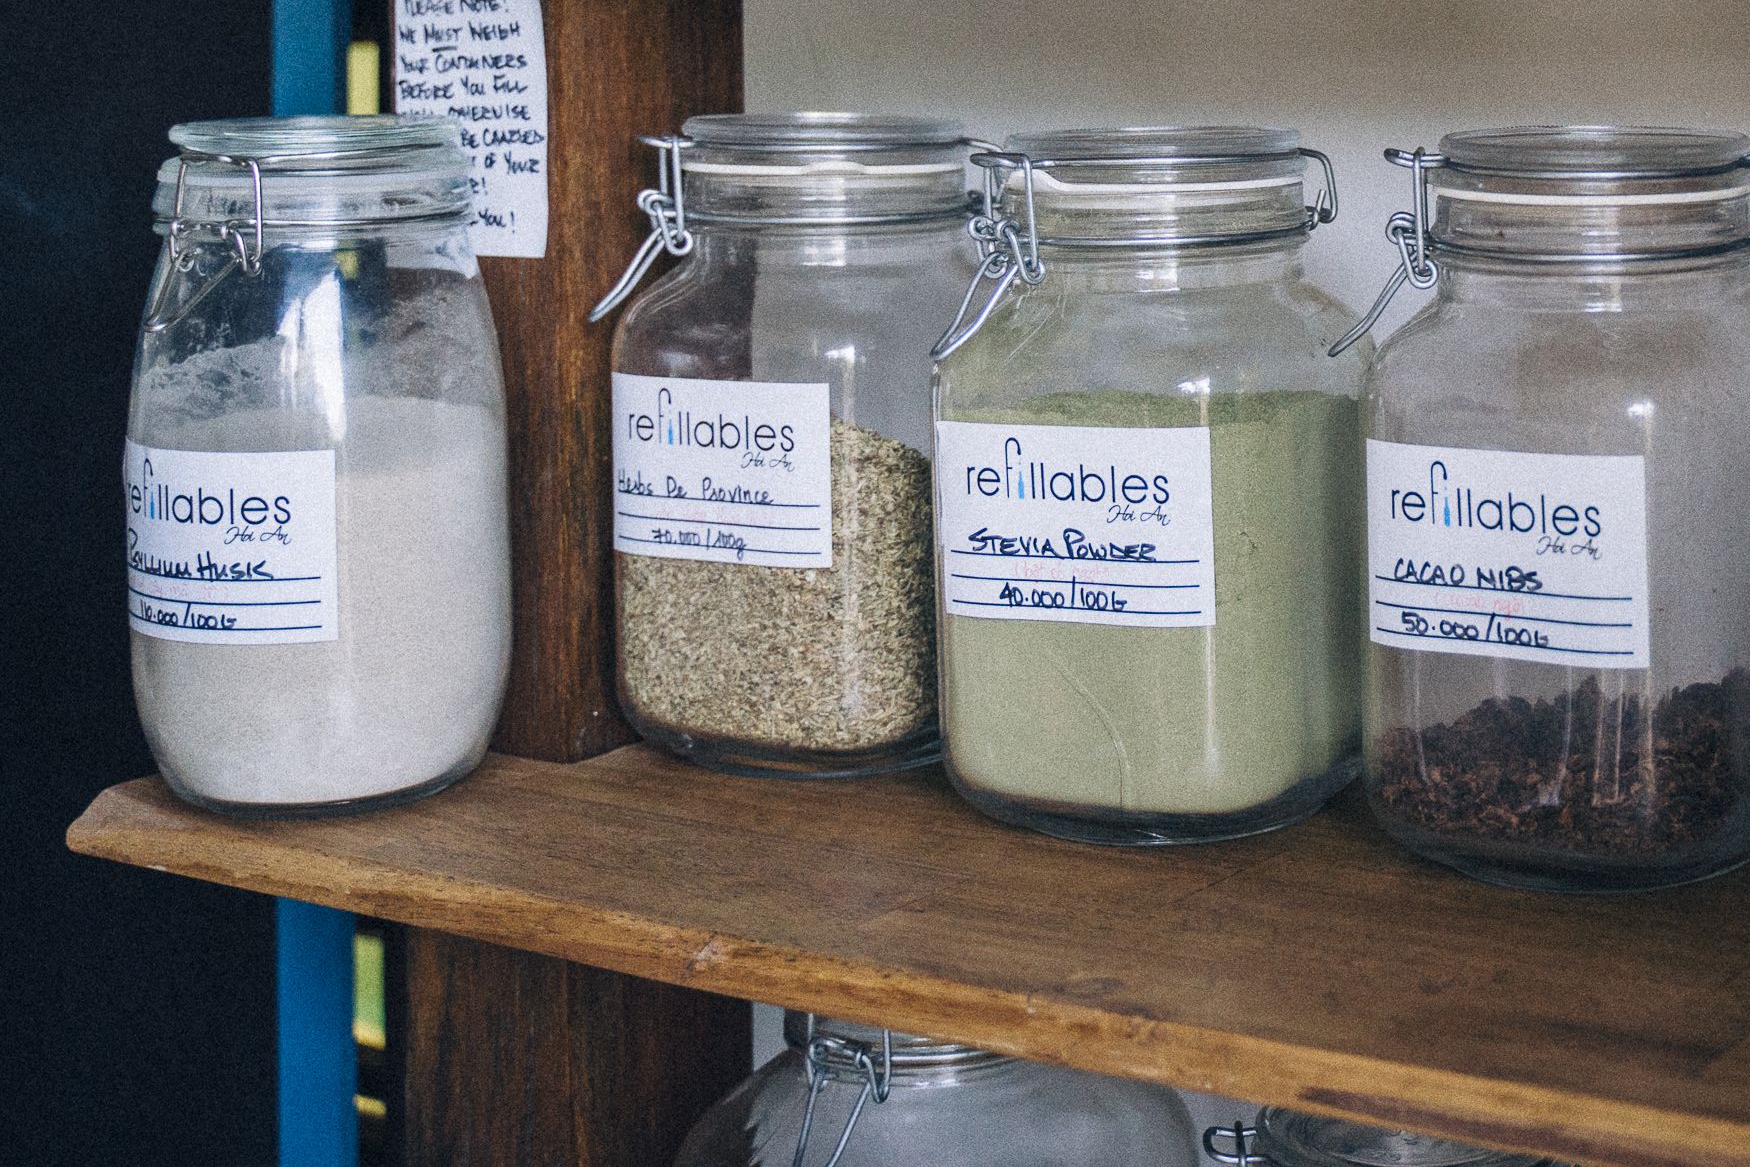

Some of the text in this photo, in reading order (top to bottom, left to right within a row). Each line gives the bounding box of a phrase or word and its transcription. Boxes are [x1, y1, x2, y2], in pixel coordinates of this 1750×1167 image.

[398, 80, 454, 100] BEFORE
[460, 76, 486, 96] YOU
[629, 387, 795, 452] refillables
[966, 437, 1170, 504] refillables
[666, 475, 687, 498] De
[702, 476, 774, 505] Province
[1391, 461, 1601, 537] refillables
[968, 527, 1156, 562] STEVIA POWDER
[1393, 558, 1543, 591] CACAO NIBS
